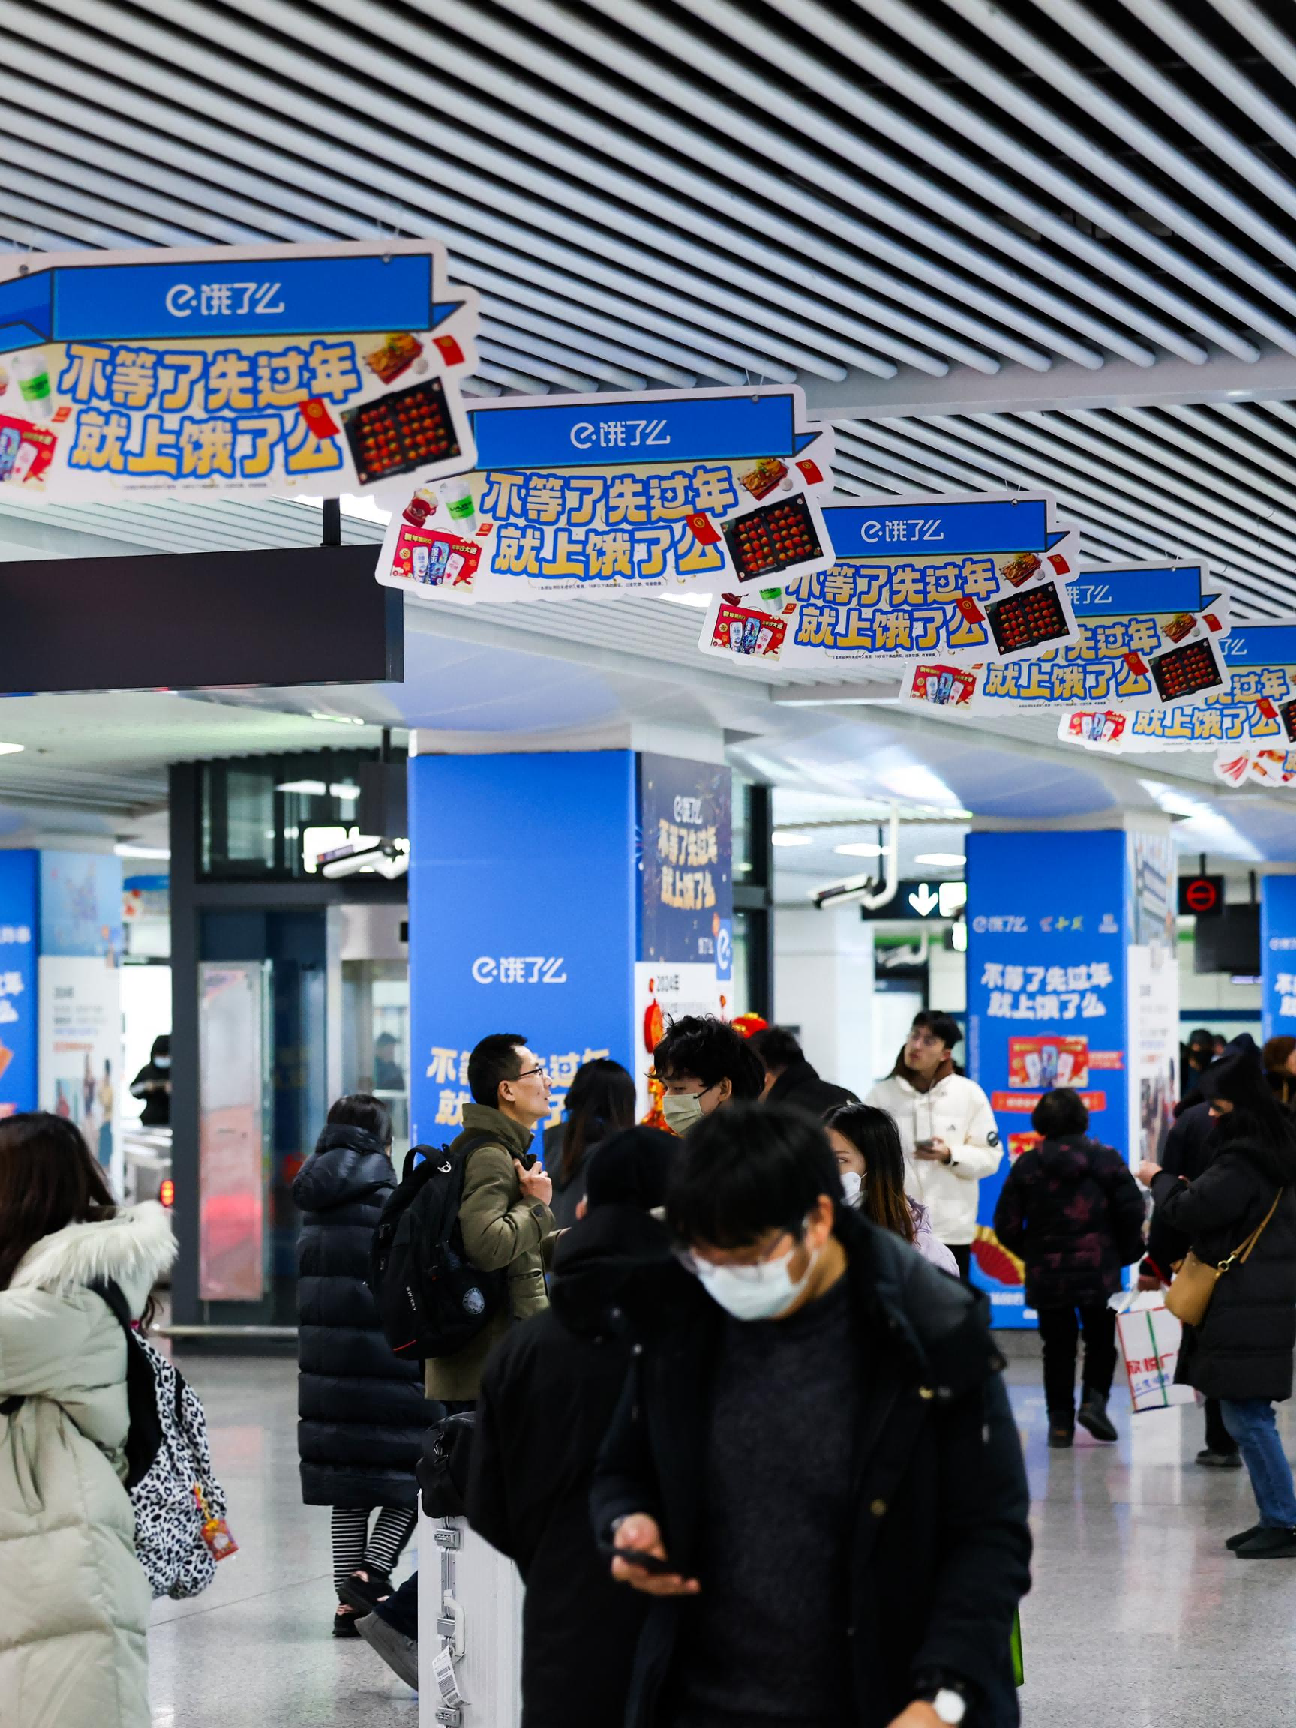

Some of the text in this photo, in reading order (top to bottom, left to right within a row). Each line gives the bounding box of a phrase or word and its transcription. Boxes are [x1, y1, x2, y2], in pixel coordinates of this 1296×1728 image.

[59, 341, 361, 413] 不等了先过年
[71, 411, 343, 479] 就上饿了么
[481, 466, 740, 526] 不等了先过年
[493, 522, 724, 581] 就上饿了么
[793, 604, 989, 652] 就上饿了么
[984, 661, 1153, 701] 就上饿了么
[1132, 705, 1281, 740] 就上饿了么
